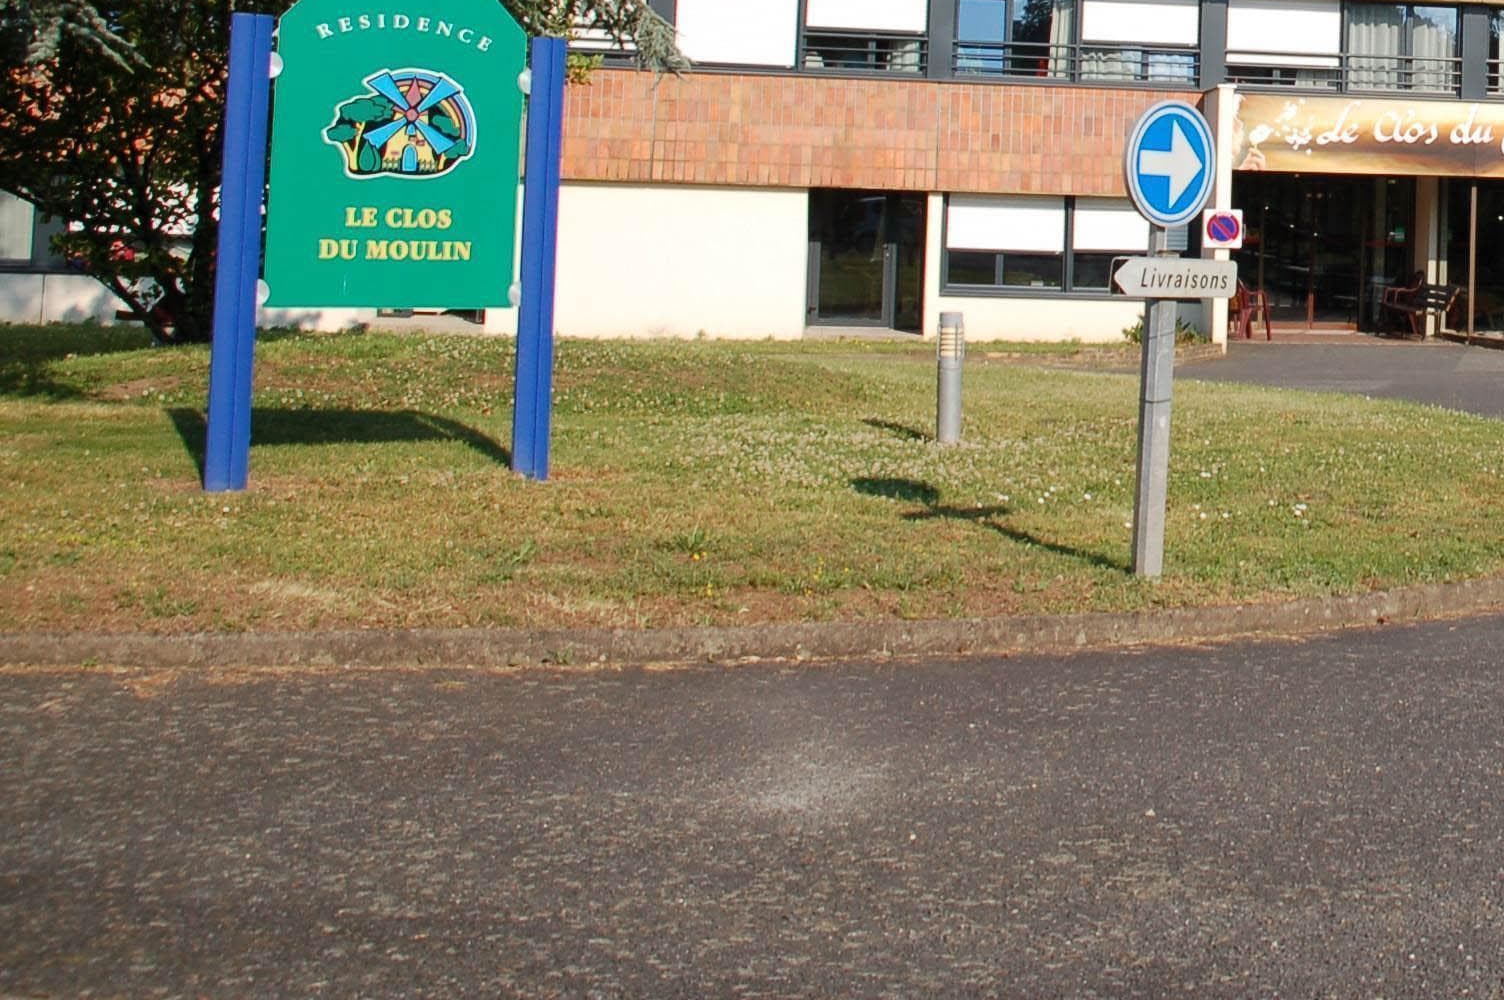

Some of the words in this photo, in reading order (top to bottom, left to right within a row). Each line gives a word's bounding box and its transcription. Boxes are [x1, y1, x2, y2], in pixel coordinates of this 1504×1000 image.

[315, 13, 493, 52] RESIDENCE
[1373, 107, 1438, 144] Clos
[1450, 103, 1494, 144] du
[345, 207, 378, 228] LE
[385, 208, 453, 230] CLOS
[318, 238, 359, 260] DU
[365, 239, 472, 261] MOULIN
[1140, 267, 1229, 290] Livraisons
